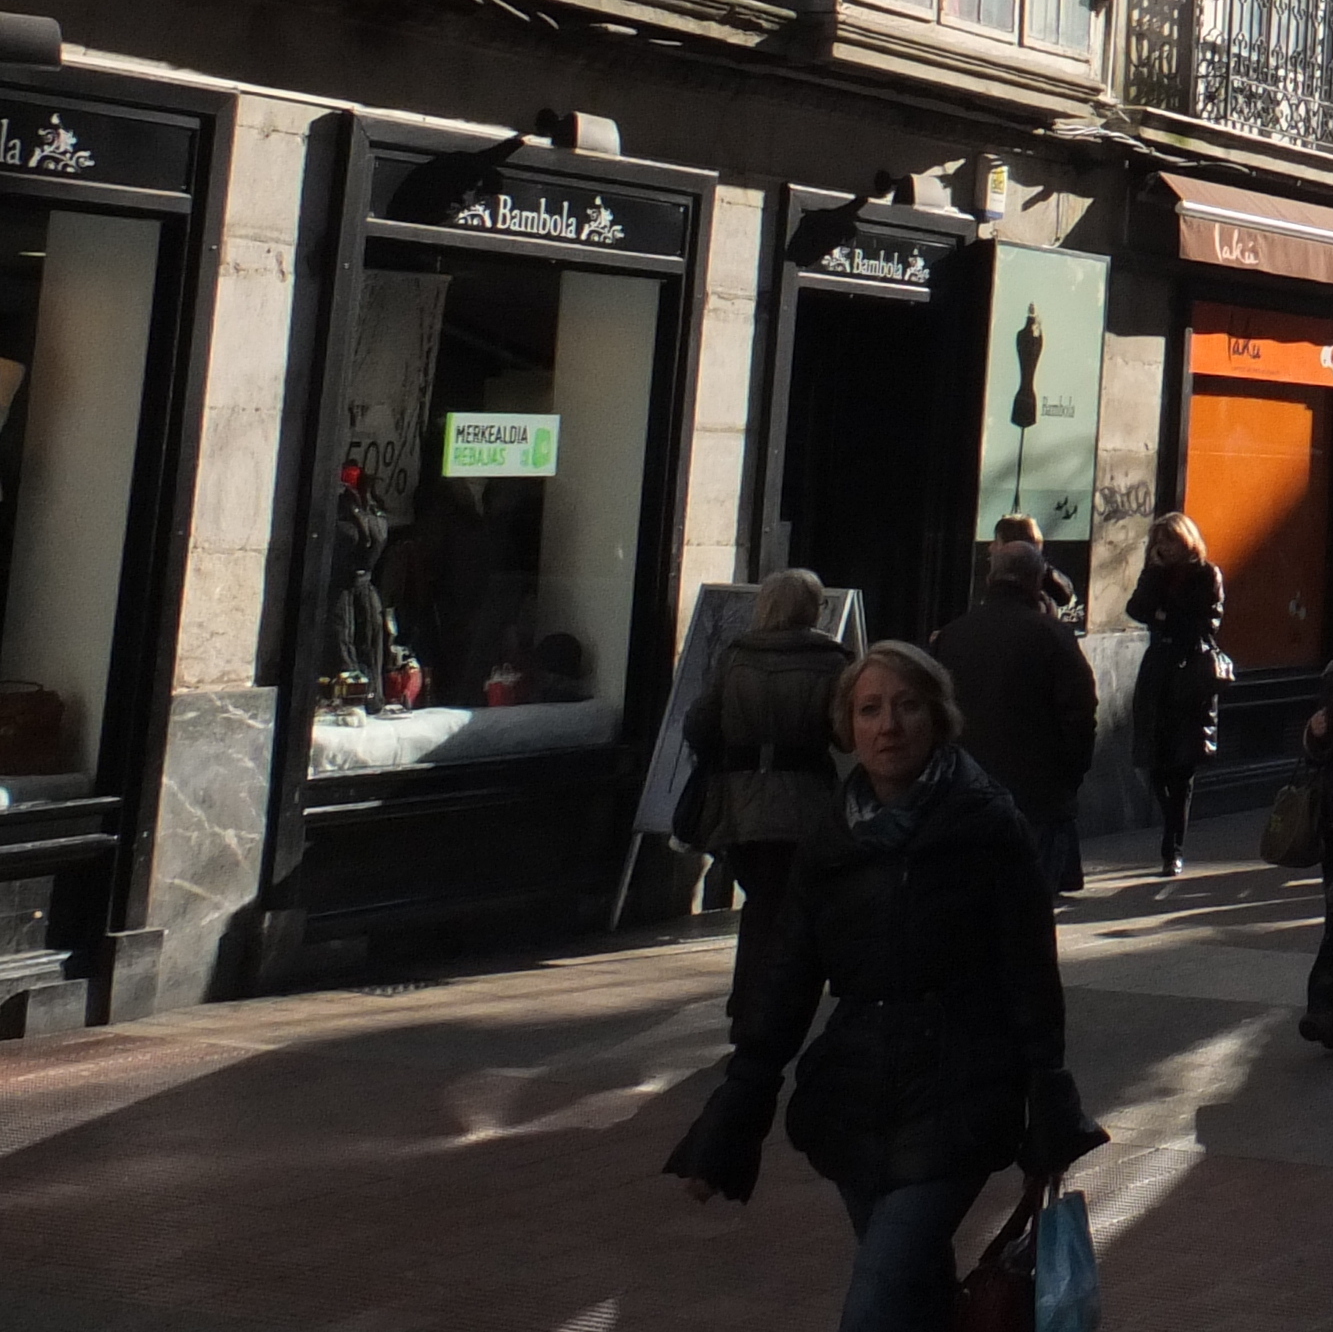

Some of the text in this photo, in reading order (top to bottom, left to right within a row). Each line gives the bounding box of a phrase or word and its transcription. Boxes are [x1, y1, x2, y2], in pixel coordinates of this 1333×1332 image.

[496, 193, 578, 240] Bambola
[852, 248, 903, 280] Bambola
[455, 424, 529, 445] MERKEALDIA
[453, 446, 507, 466] REBAJAS
